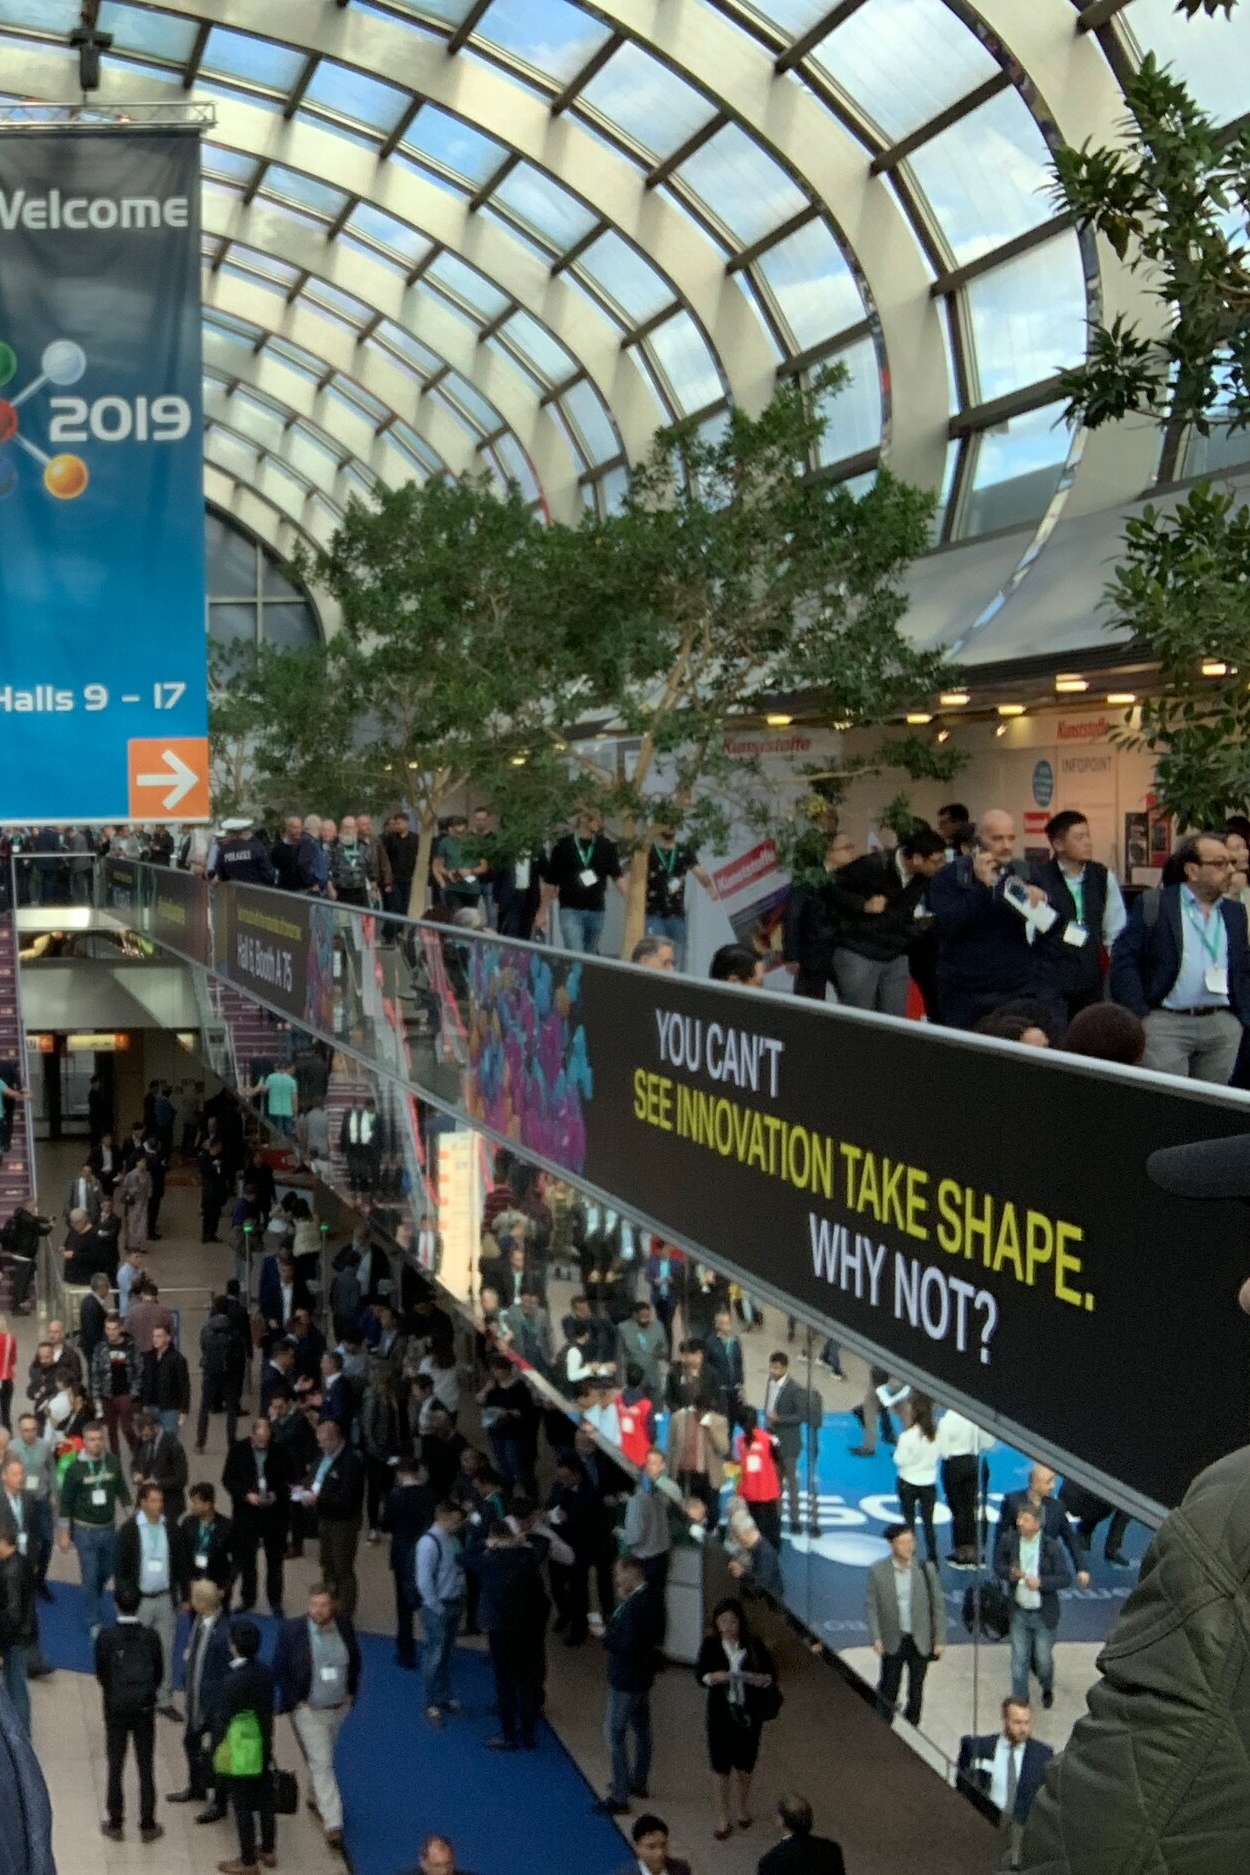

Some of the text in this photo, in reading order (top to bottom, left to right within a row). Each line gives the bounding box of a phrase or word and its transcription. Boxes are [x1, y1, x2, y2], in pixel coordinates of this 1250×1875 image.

[49, 396, 192, 443] 2019
[83, 683, 110, 712] 9
[153, 682, 187, 710] 17
[1061, 756, 1112, 774] INFOPOINT
[655, 1008, 785, 1098] YOU CAN'T
[634, 1067, 1095, 1312] SEE INNOVATION TAKE SHAPE.
[809, 1212, 999, 1365] WHY NOT?
